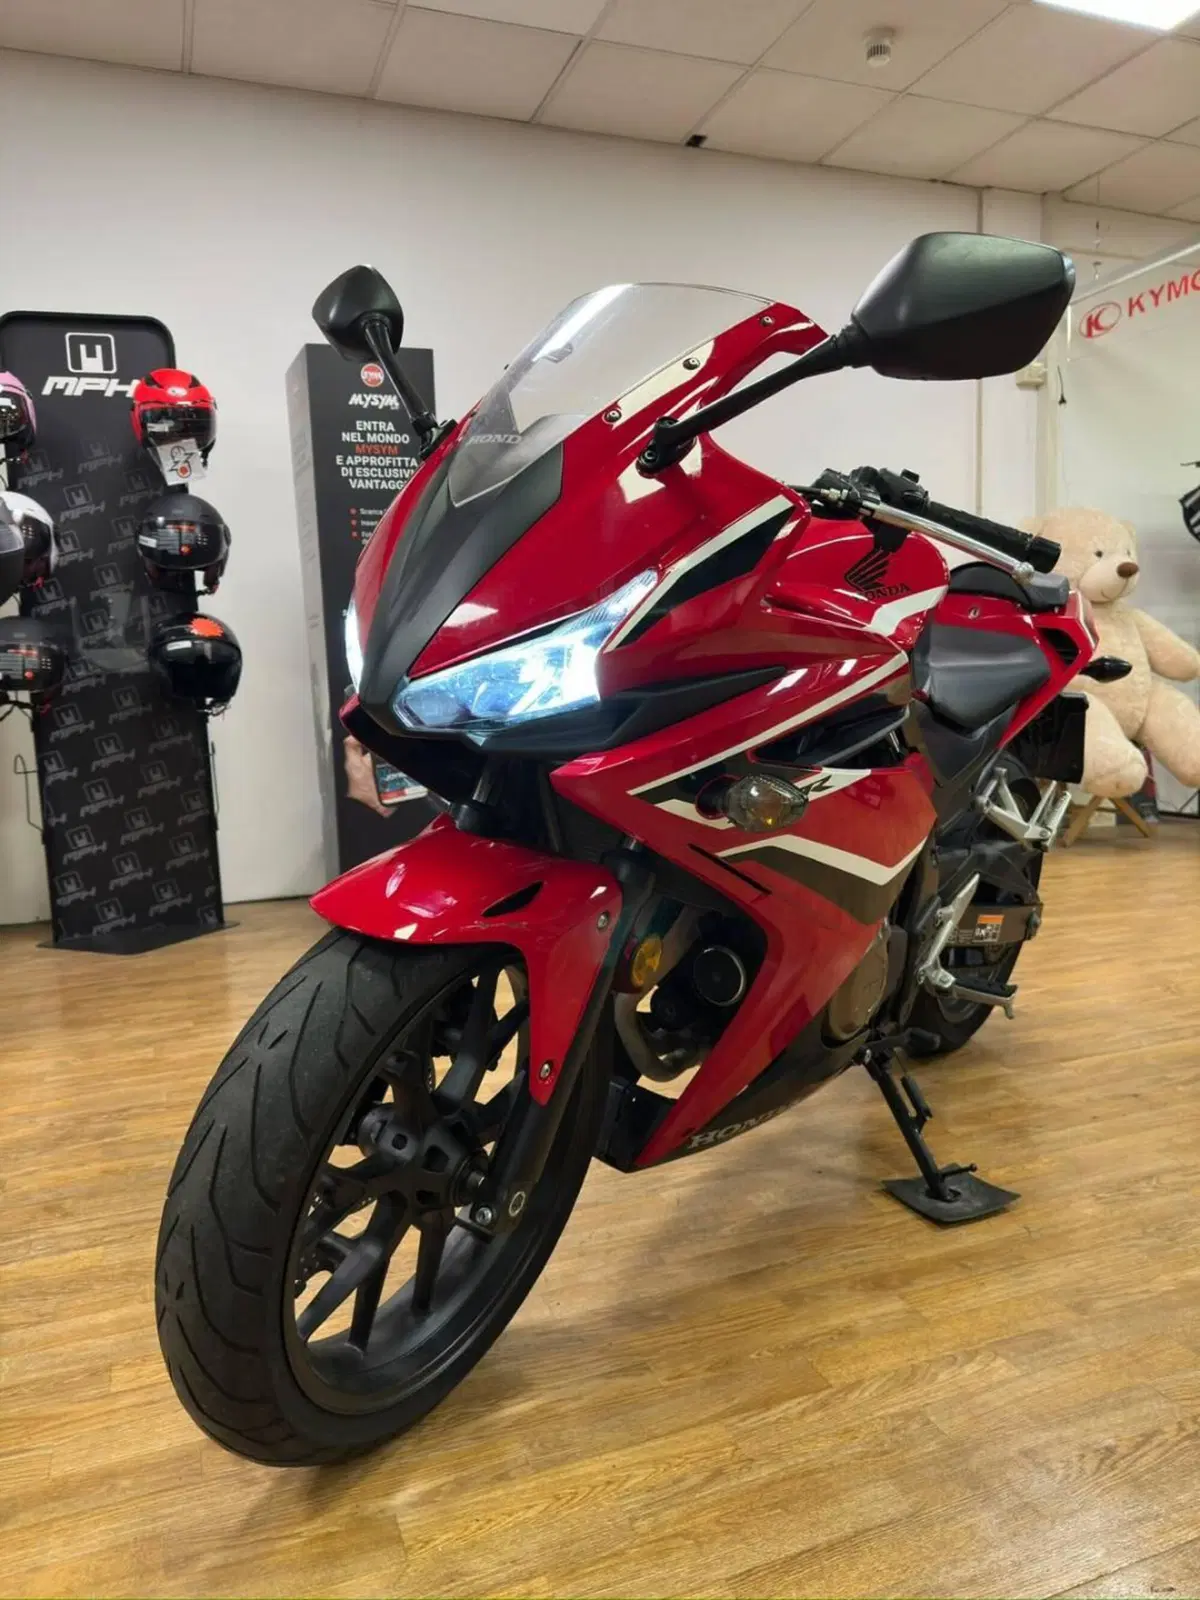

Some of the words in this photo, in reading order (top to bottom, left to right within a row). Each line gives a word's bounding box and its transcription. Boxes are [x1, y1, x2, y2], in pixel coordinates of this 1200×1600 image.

[348, 393, 399, 409] MYSYM
[355, 420, 395, 432] ENTRA
[341, 432, 364, 443] NEL
[367, 433, 410, 444] MONDO
[355, 444, 399, 455] MYSYM
[335, 455, 344, 465] E
[346, 456, 418, 467] APPROFITTA
[341, 467, 353, 477] DI
[349, 479, 407, 490] VANTAGG
